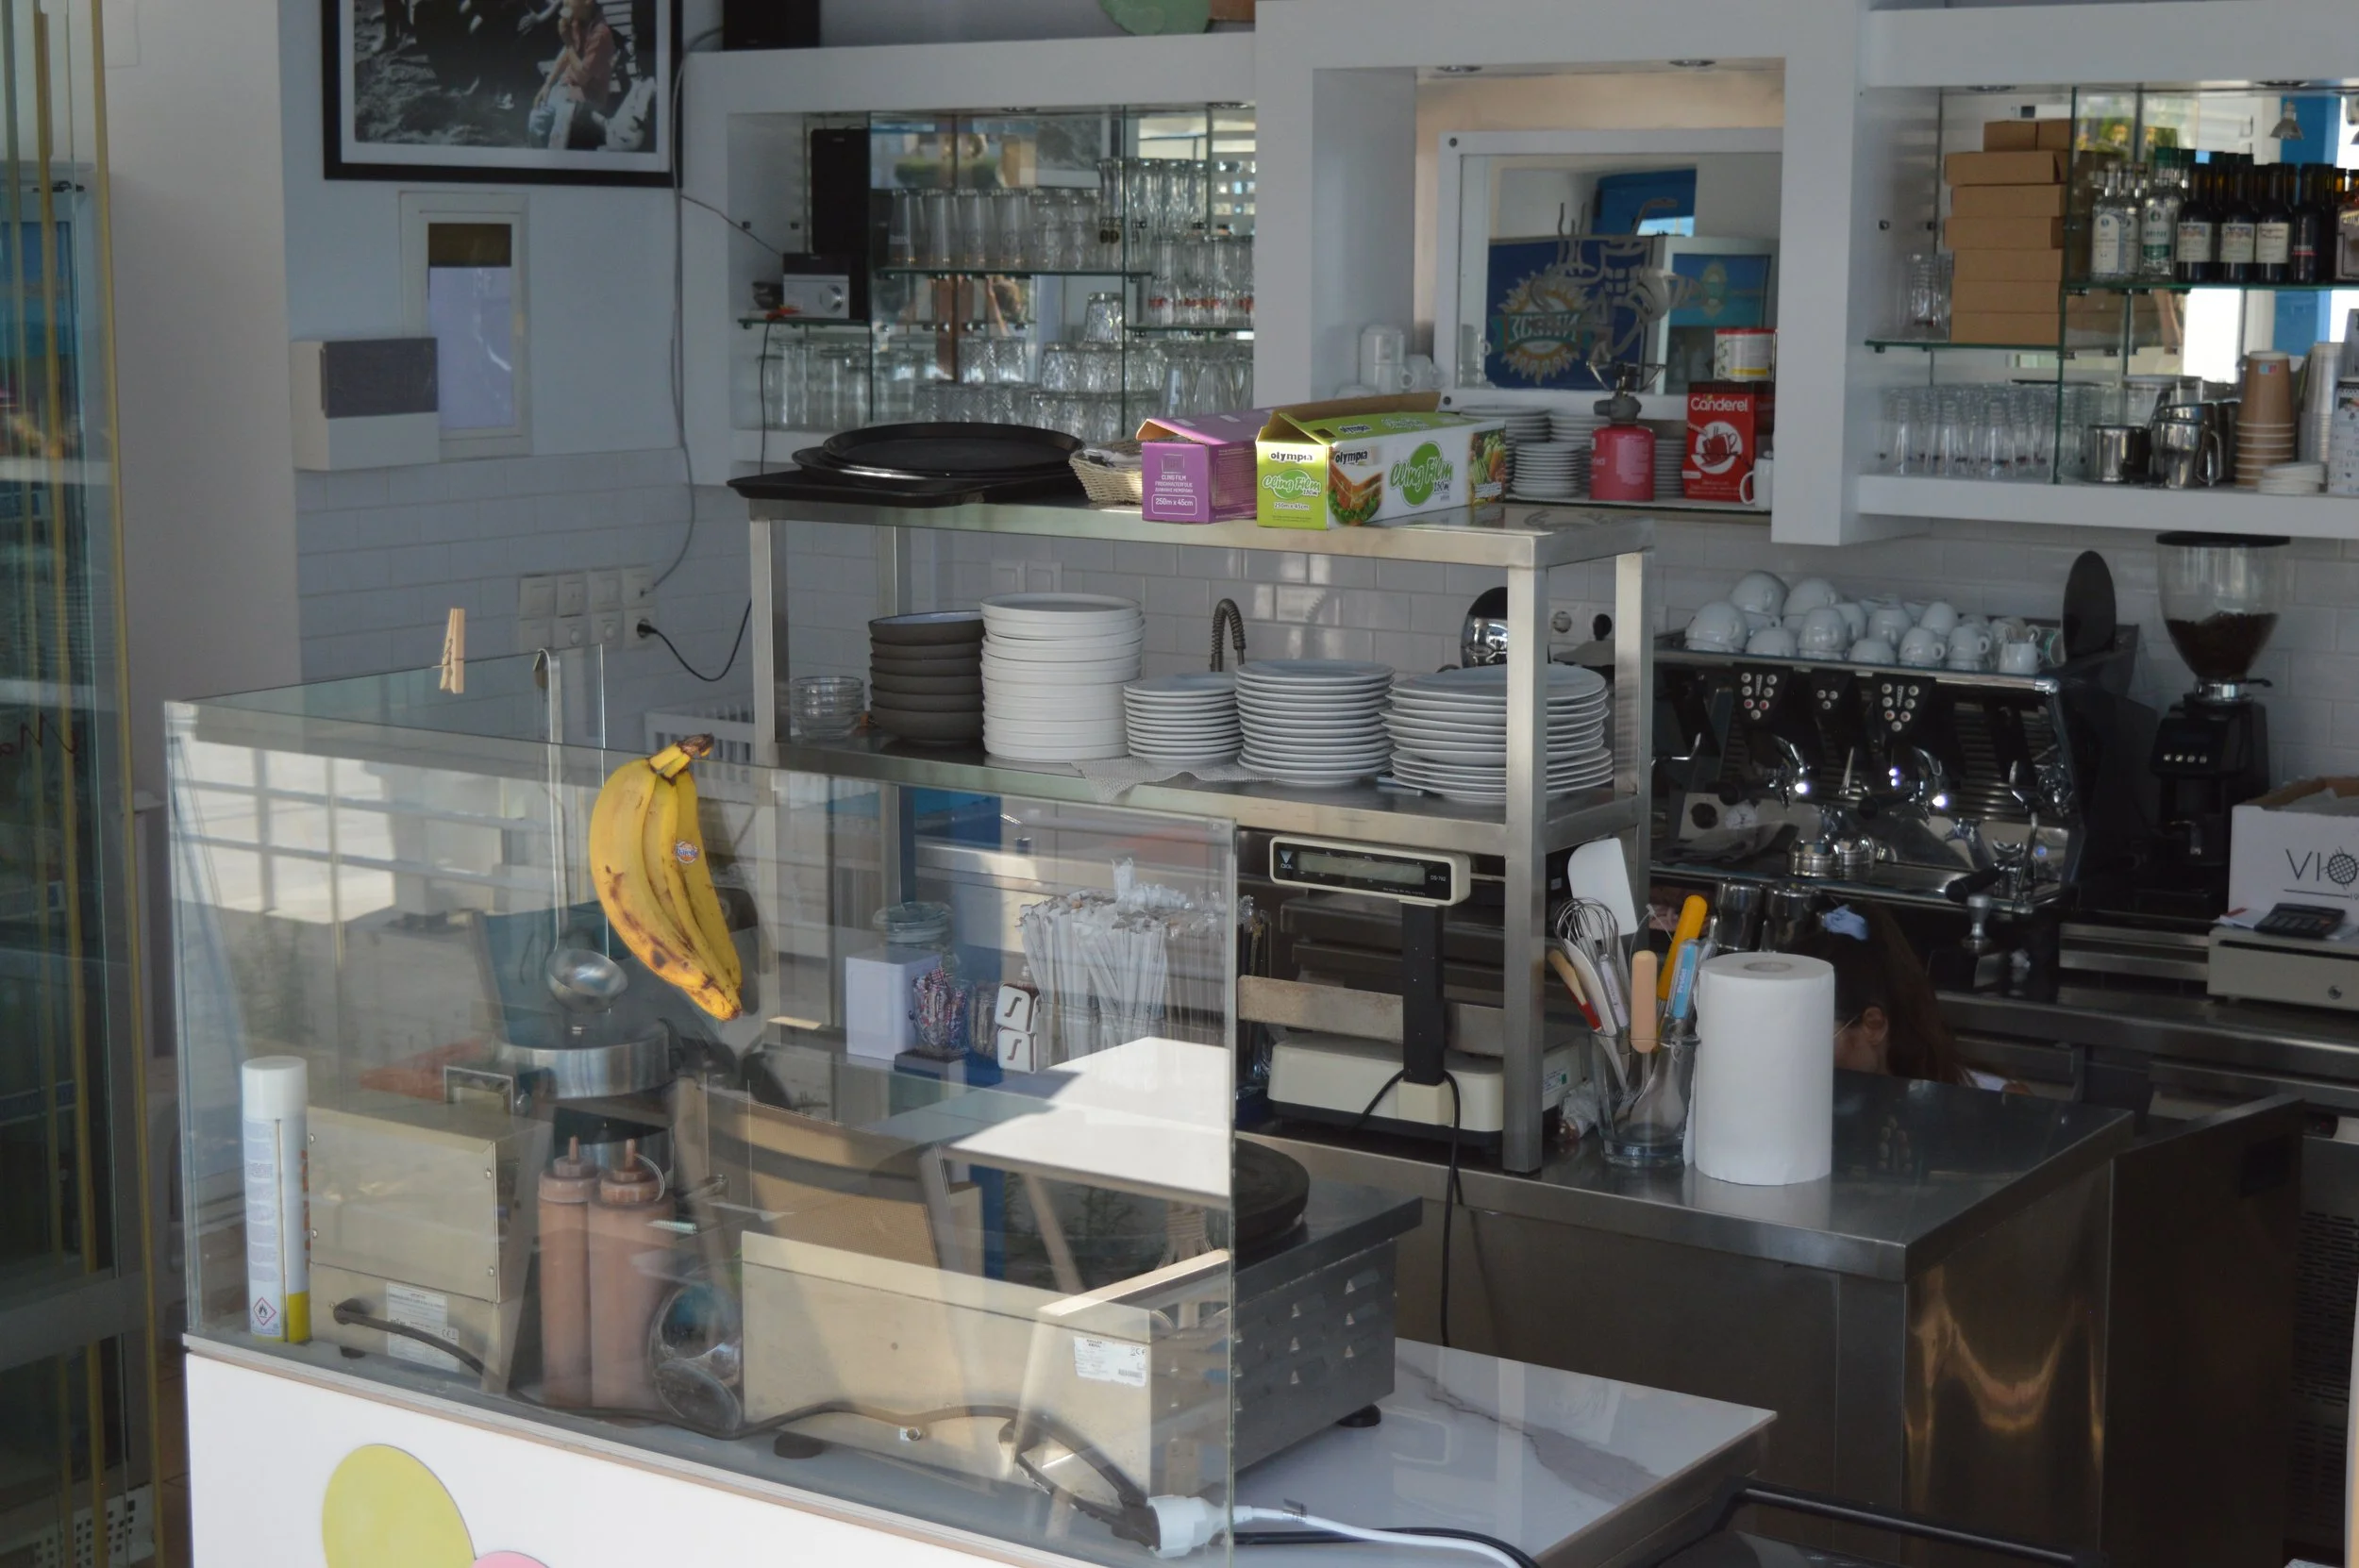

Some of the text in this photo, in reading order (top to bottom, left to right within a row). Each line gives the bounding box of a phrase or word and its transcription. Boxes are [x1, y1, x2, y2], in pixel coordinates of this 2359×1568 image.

[1690, 396, 1748, 411] Canderel
[1270, 451, 1313, 463] olympia
[1334, 450, 1368, 465] olympia
[1389, 457, 1453, 492] Cling Film
[1263, 474, 1321, 492] Cling Film
[1155, 497, 1173, 506] 250m
[1178, 498, 1194, 507] 45cm
